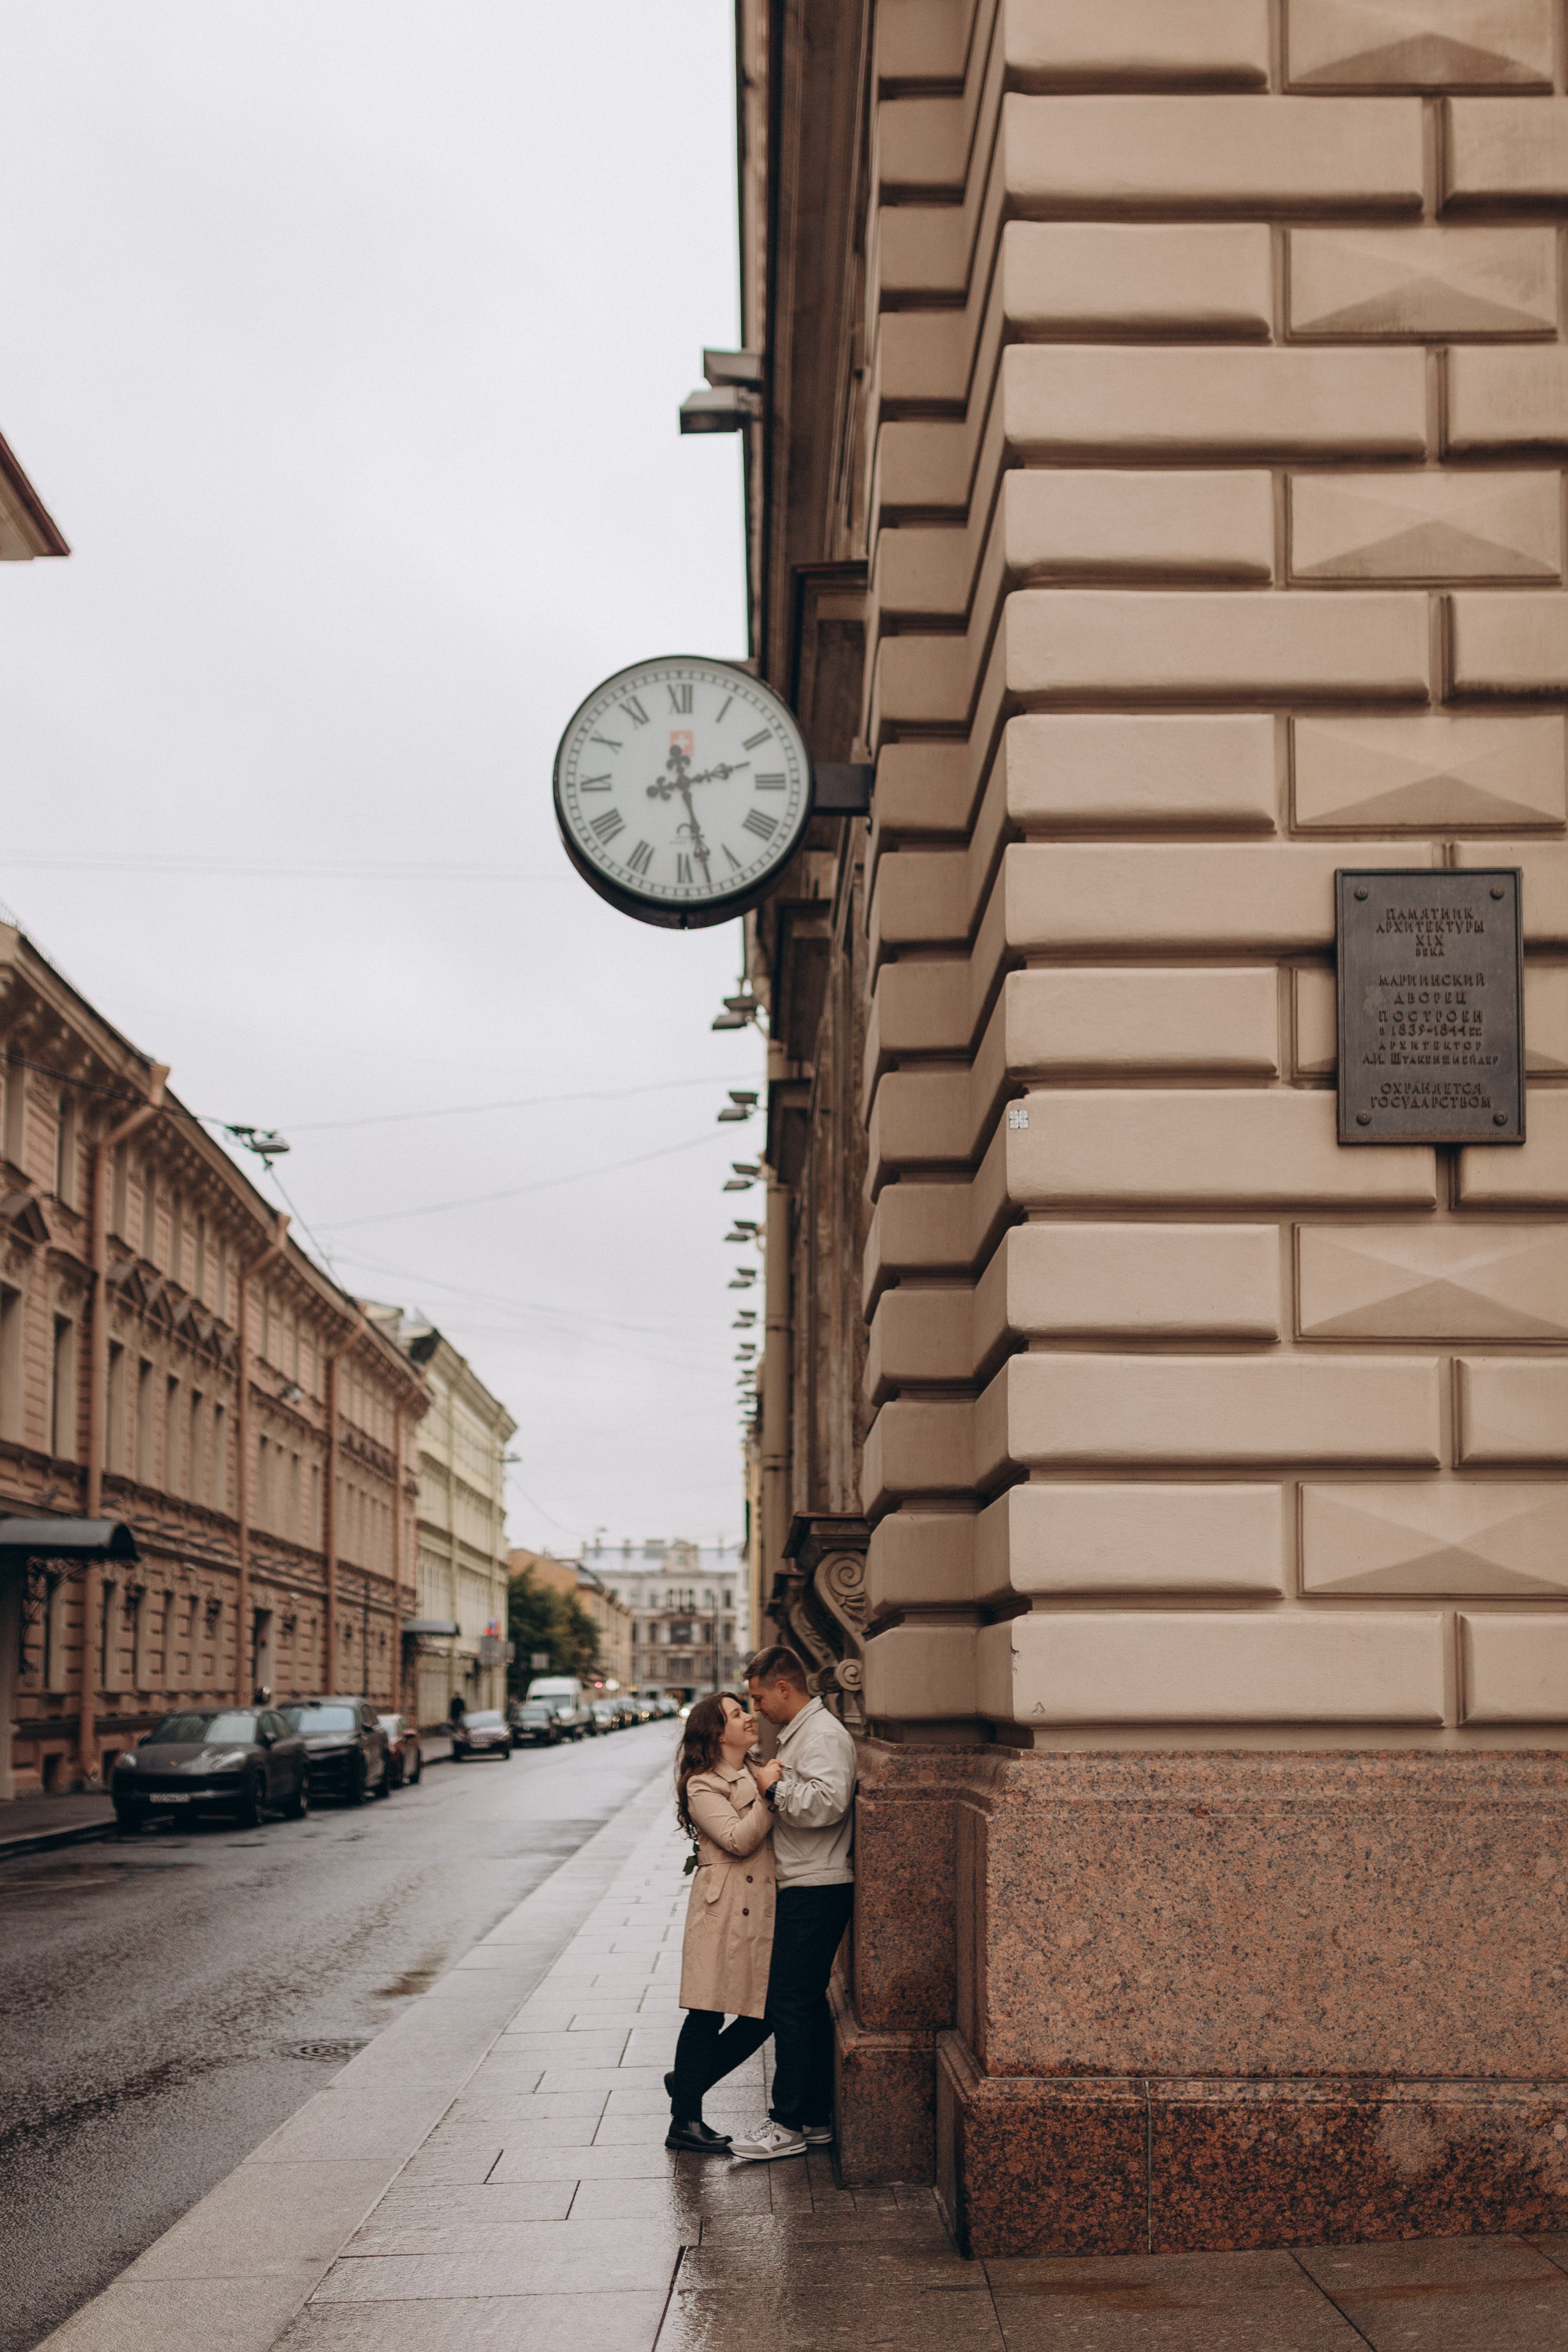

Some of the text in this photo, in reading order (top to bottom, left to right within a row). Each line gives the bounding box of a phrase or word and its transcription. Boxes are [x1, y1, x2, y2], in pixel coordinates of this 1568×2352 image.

[1386, 907, 1474, 919] ПАМЯТНИК
[1376, 920, 1485, 934] АРХИТЕКТУРЫ
[1415, 934, 1444, 946] XIX
[1415, 948, 1445, 957] ВЕКА
[1379, 973, 1486, 987] МАРИИНСКИЙ
[1394, 992, 1466, 1005] ДВОРЕЦ
[1379, 1010, 1483, 1023] ПОСТРОЕН
[1392, 1023, 1467, 1036] 1839-1844
[1379, 1041, 1482, 1051] АРХИТЕКТОР
[1381, 1082, 1482, 1095] ОХРАНЯЕТСЯ
[1371, 1096, 1491, 1109] ГОСУДАРСТВОМ
